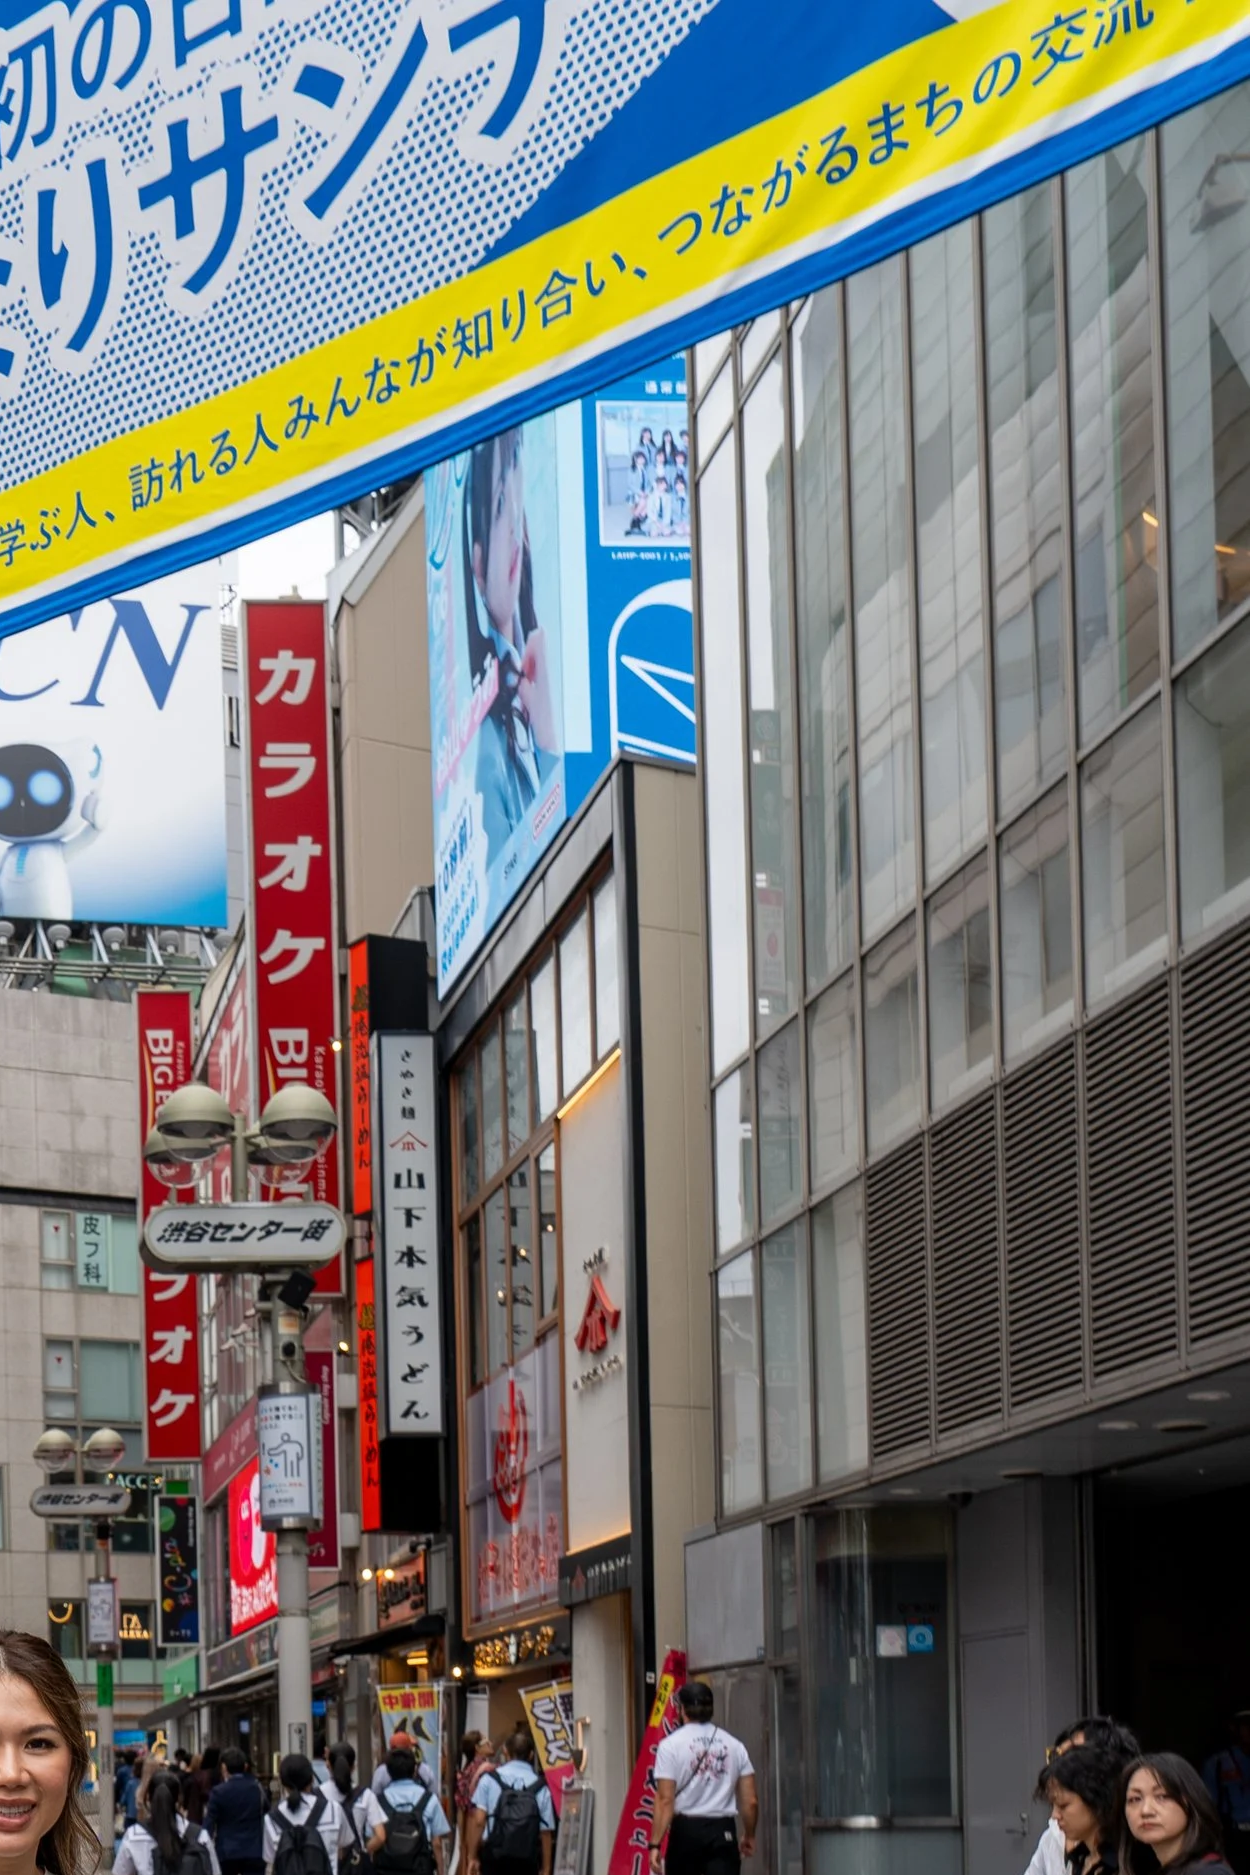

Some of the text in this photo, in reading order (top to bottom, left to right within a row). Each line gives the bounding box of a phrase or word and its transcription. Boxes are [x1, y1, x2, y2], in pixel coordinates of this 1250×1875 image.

[255, 649, 325, 985] カラオケ
[146, 1028, 174, 1089] BIG
[268, 1028, 309, 1083] BI
[82, 1214, 102, 1284] 皮フ科
[156, 1218, 335, 1243] 渋谷センター街
[393, 1168, 429, 1420] 山下本気うどん
